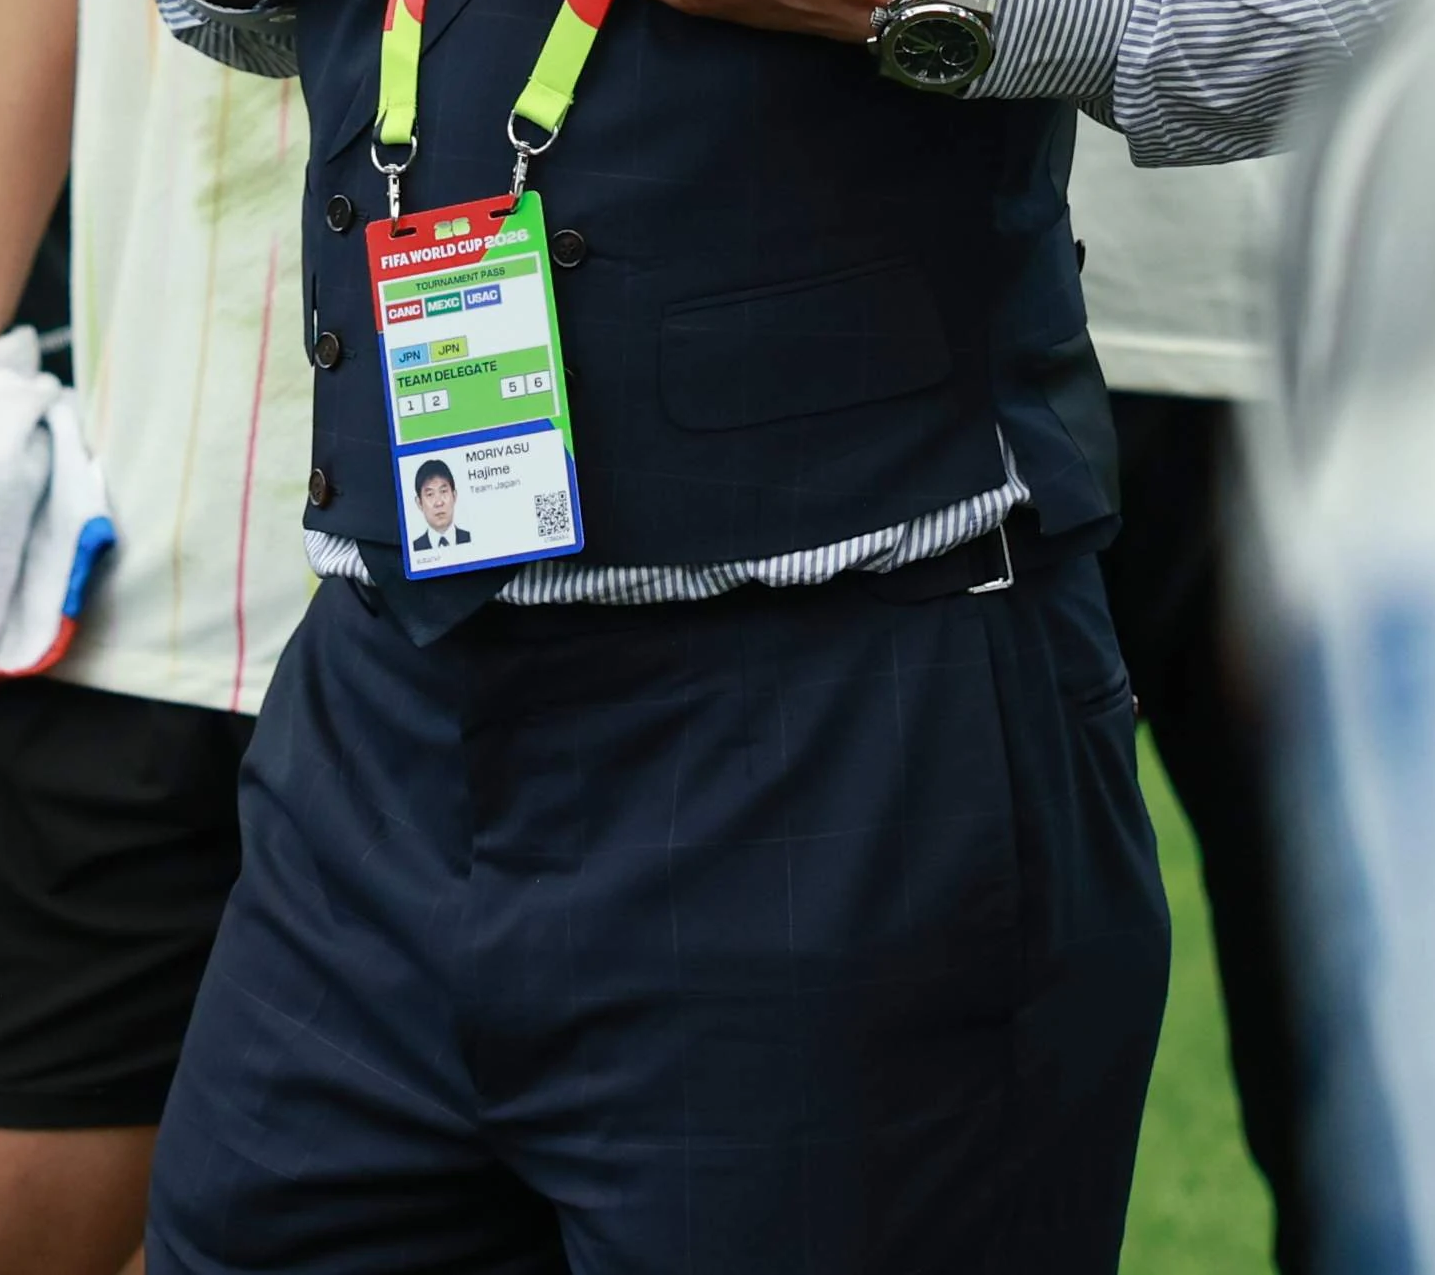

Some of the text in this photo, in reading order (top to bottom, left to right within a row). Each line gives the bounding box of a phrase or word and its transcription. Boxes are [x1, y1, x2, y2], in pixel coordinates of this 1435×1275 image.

[381, 228, 528, 270] FIFA WORLD CUP 2026
[415, 267, 505, 292] TOURNAMENT PASS
[388, 290, 499, 321] CANC MEXC USAC
[398, 343, 460, 363] JPN JPN
[396, 360, 498, 388] TEAM DELEGATE
[407, 376, 544, 411] 1 2 5 6
[465, 441, 530, 463] MORIYASU
[467, 464, 511, 481] Hajime
[469, 478, 521, 494] Team Japan
